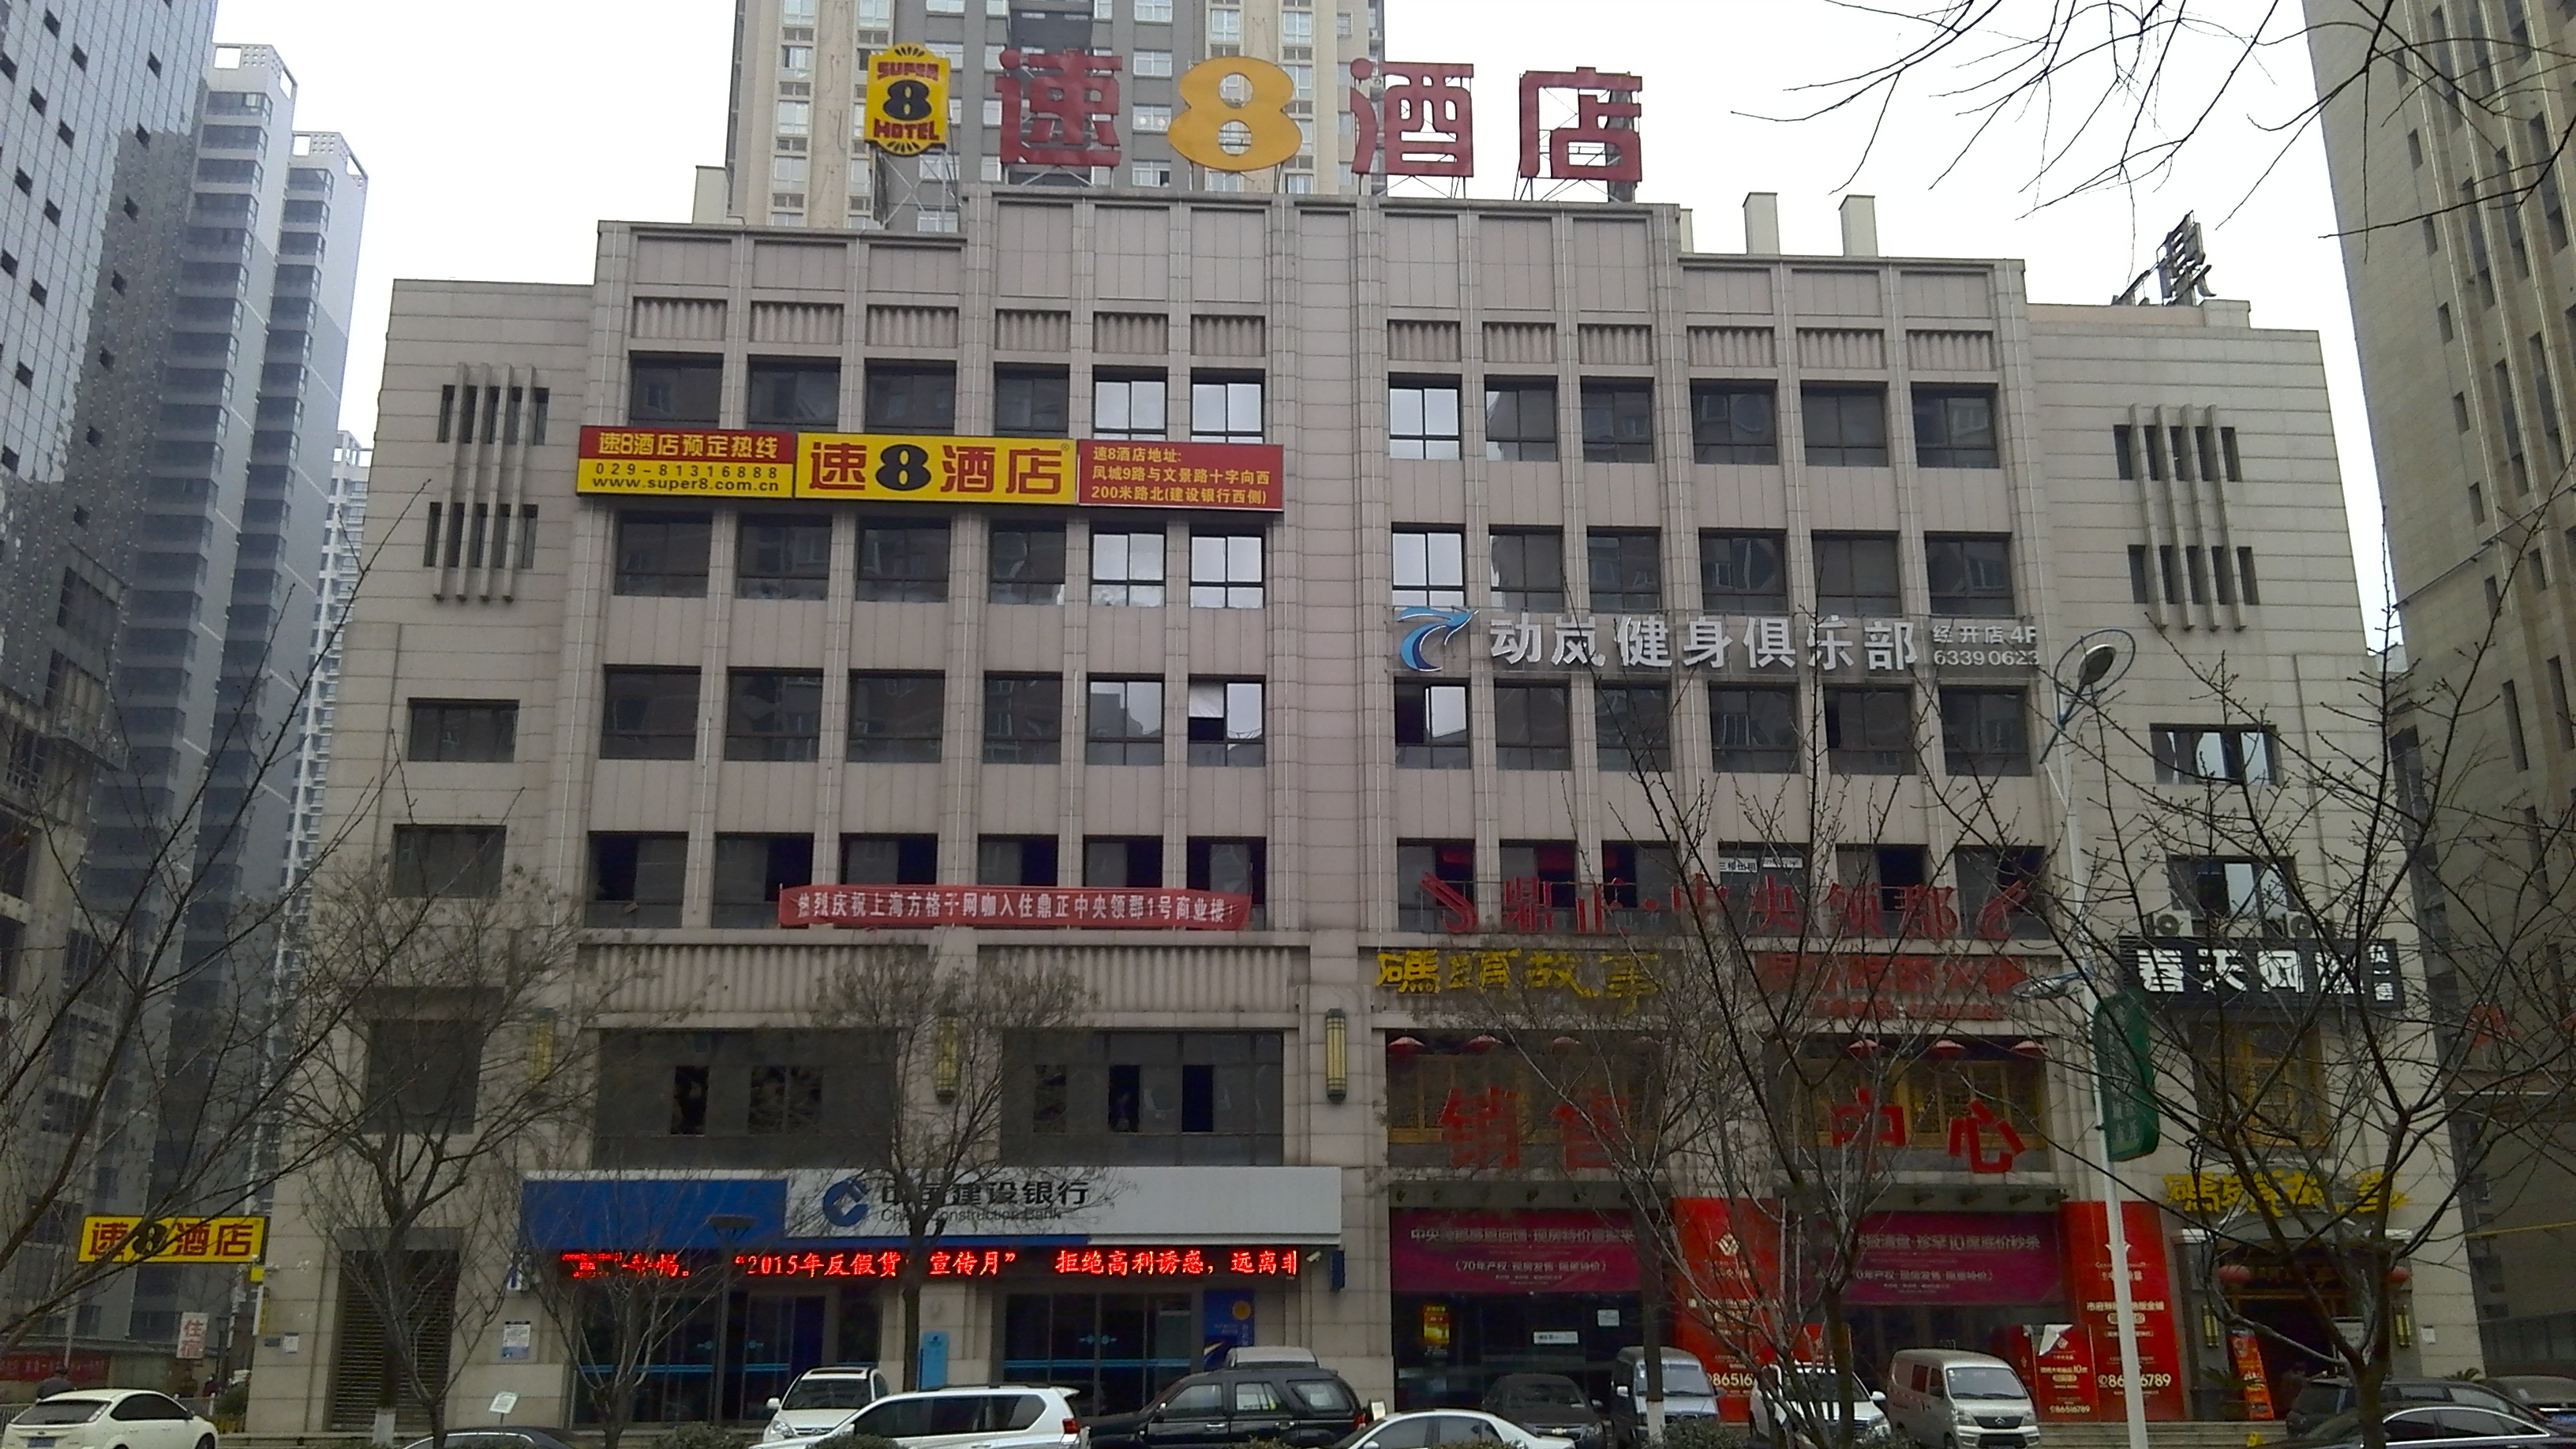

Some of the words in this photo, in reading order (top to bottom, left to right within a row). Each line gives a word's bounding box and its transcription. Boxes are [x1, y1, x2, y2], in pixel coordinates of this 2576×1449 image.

[877, 61, 939, 81] SUPER
[883, 80, 933, 120] 8
[874, 118, 940, 140] HOTEL
[597, 432, 778, 459] 速8酒店预定热线
[595, 462, 777, 479] 029-81316888
[810, 440, 1062, 495] 速8酒店
[1091, 465, 1271, 486] 凤城9路与文景路十字向西
[593, 476, 780, 492] www.super8.com.cn
[1489, 613, 1917, 672] 动岚健身俱乐部
[1932, 624, 2004, 644] 经开店
[734, 1250, 1017, 1279] “2015年反假货宣传月”
[2107, 1372, 2172, 1388] 866789
